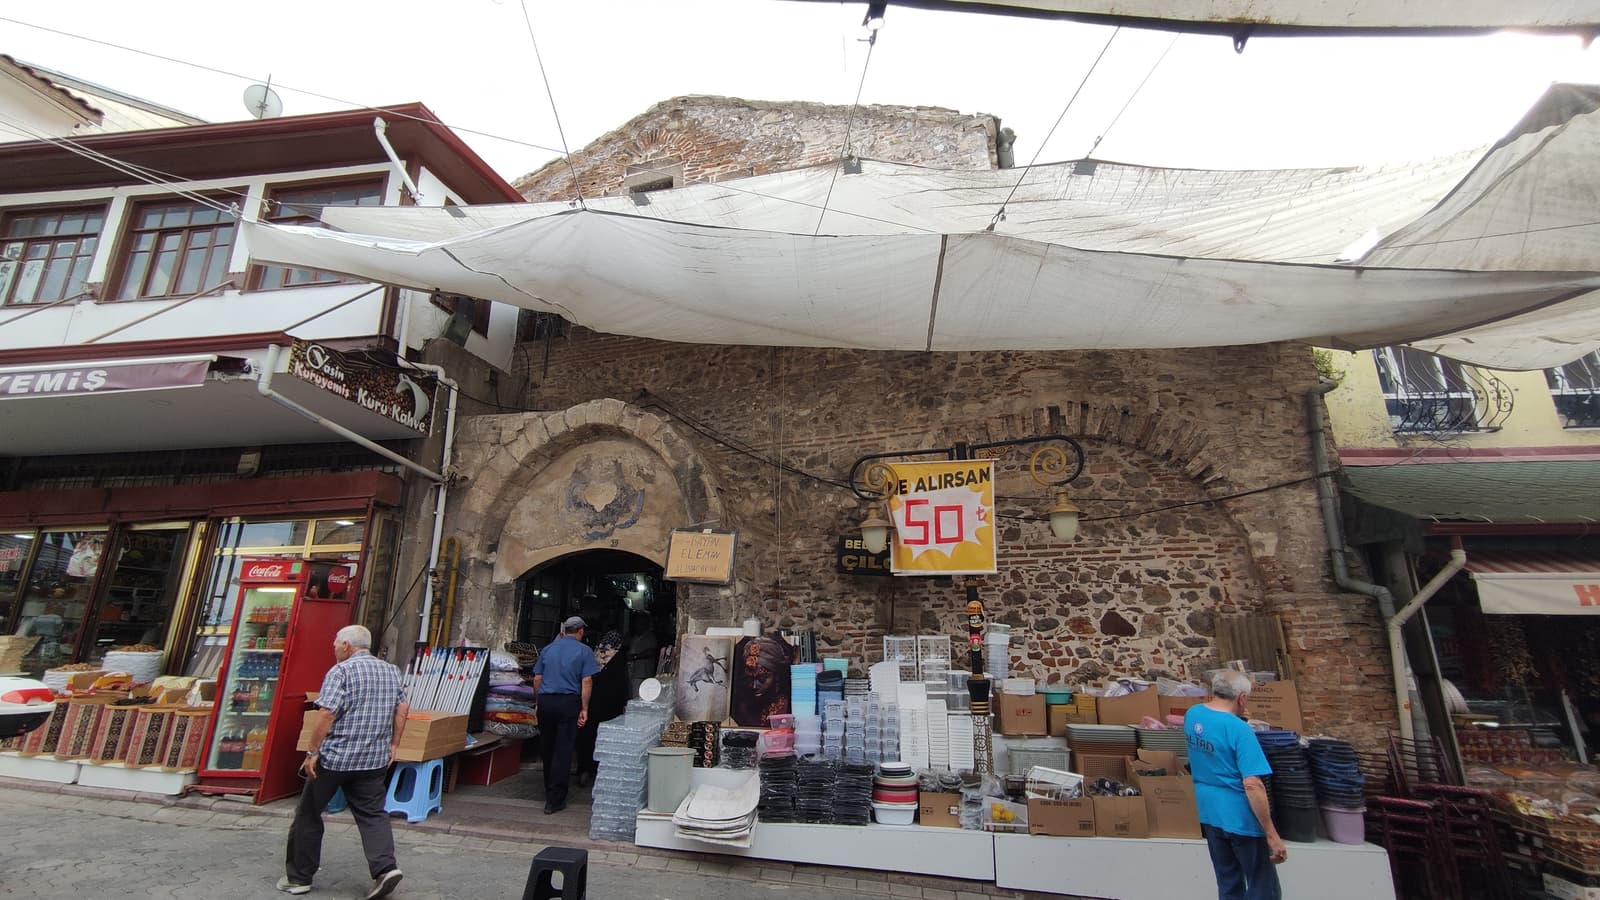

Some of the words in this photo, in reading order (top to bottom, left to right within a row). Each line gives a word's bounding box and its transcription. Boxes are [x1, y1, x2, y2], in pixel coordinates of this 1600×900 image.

[356, 387, 388, 415] Kuru
[391, 403, 426, 432] Kahve
[914, 466, 991, 493] ALIRSAN
[903, 499, 964, 545] 50
